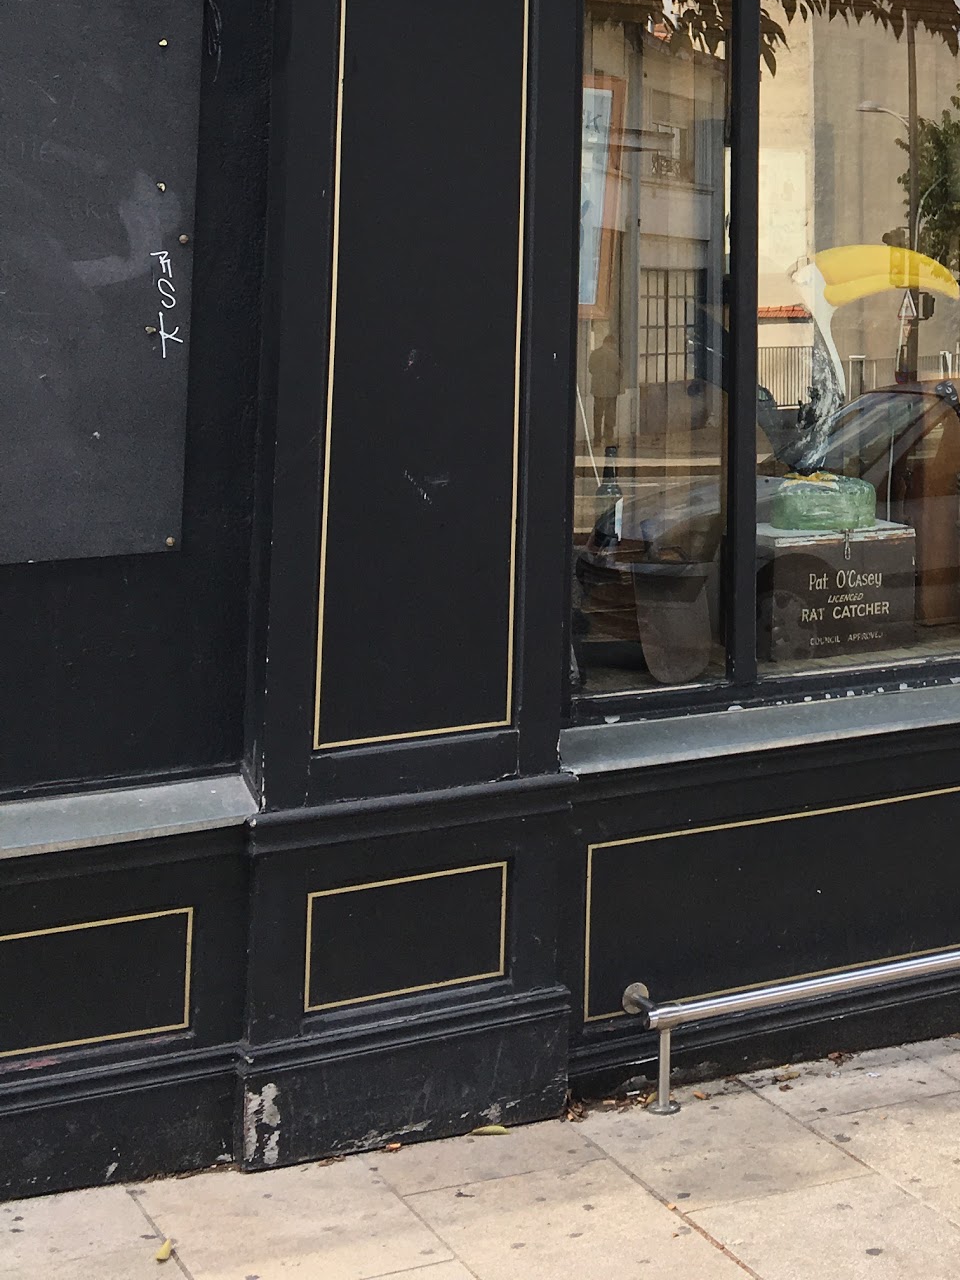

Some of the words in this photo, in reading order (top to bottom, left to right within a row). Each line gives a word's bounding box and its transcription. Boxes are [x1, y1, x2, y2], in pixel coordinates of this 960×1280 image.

[809, 573, 829, 591] Pat
[828, 592, 864, 604] LICENCED
[801, 607, 825, 623] RAT
[832, 601, 890, 620] CATCHER
[810, 635, 841, 646] COUNCIL
